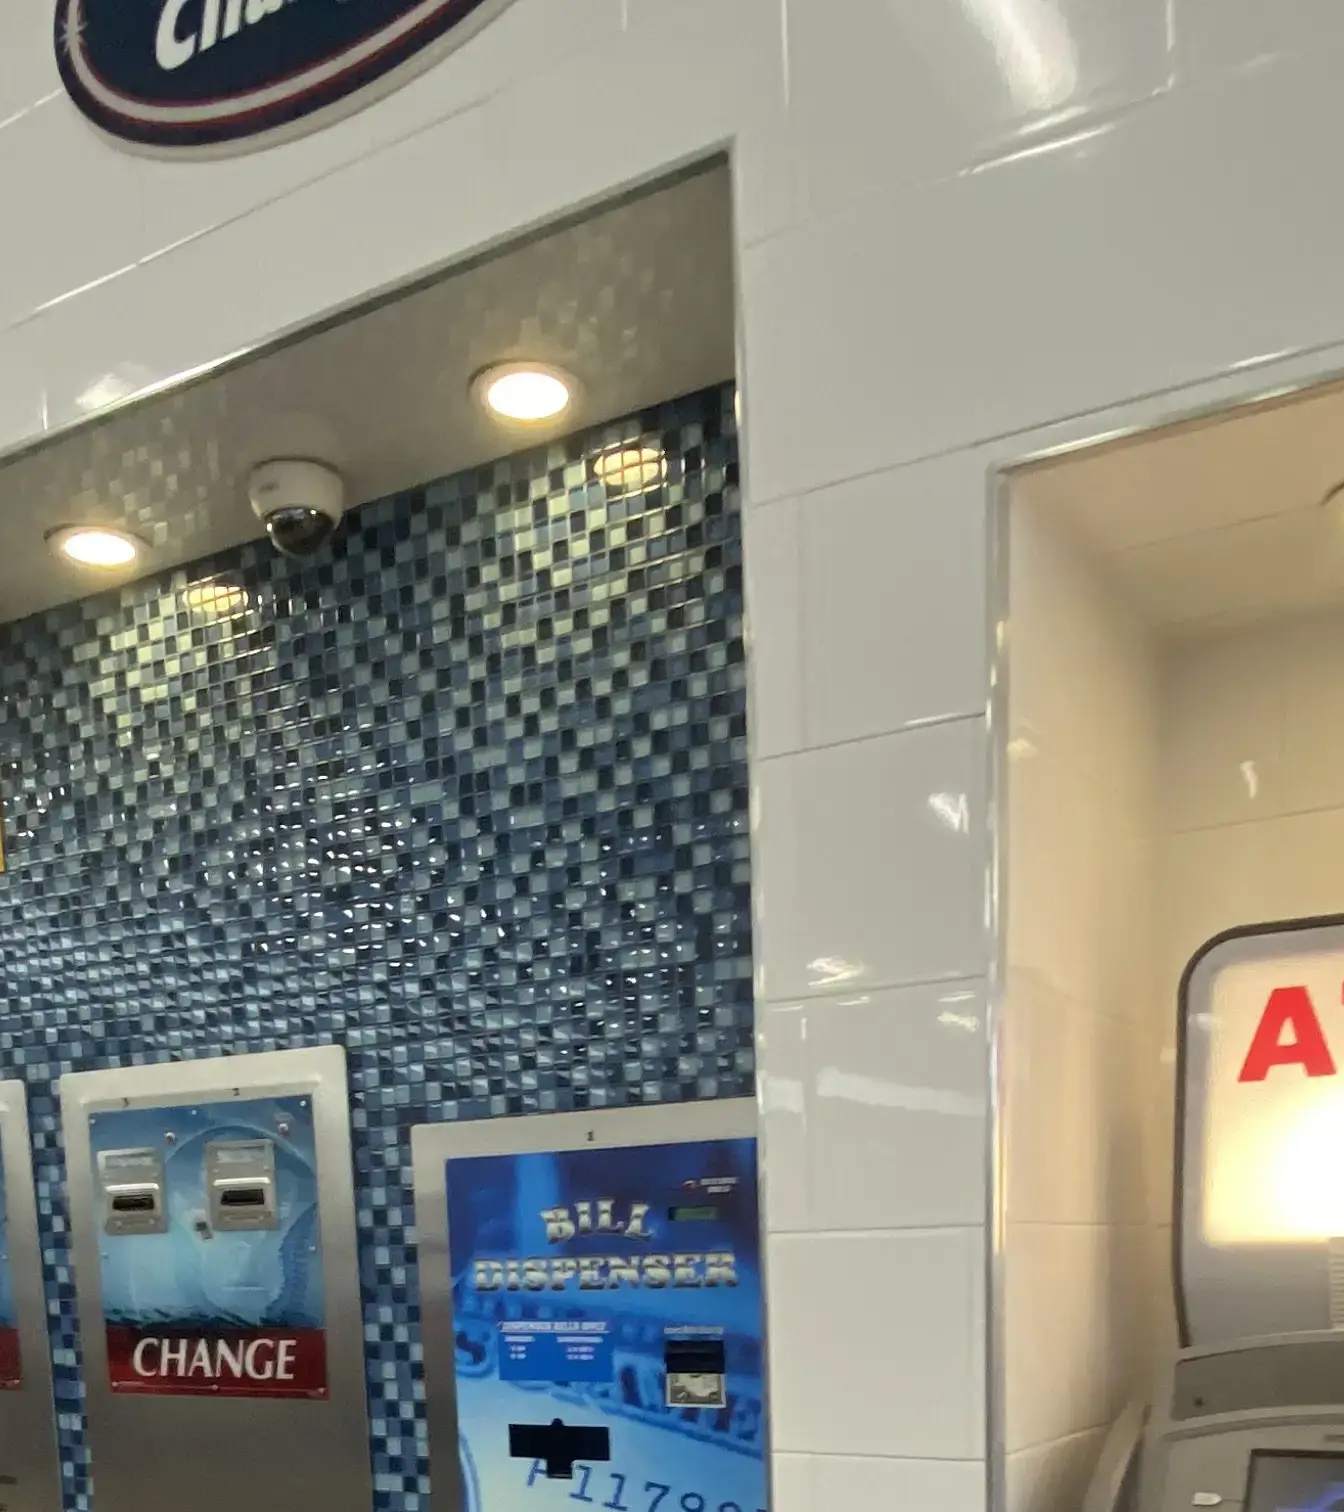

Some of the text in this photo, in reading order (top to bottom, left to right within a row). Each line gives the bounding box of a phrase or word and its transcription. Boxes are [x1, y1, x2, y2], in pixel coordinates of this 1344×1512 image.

[539, 1198, 654, 1244] BILL
[472, 1250, 740, 1292] DISPENSER
[132, 1337, 297, 1381] CHANGE
